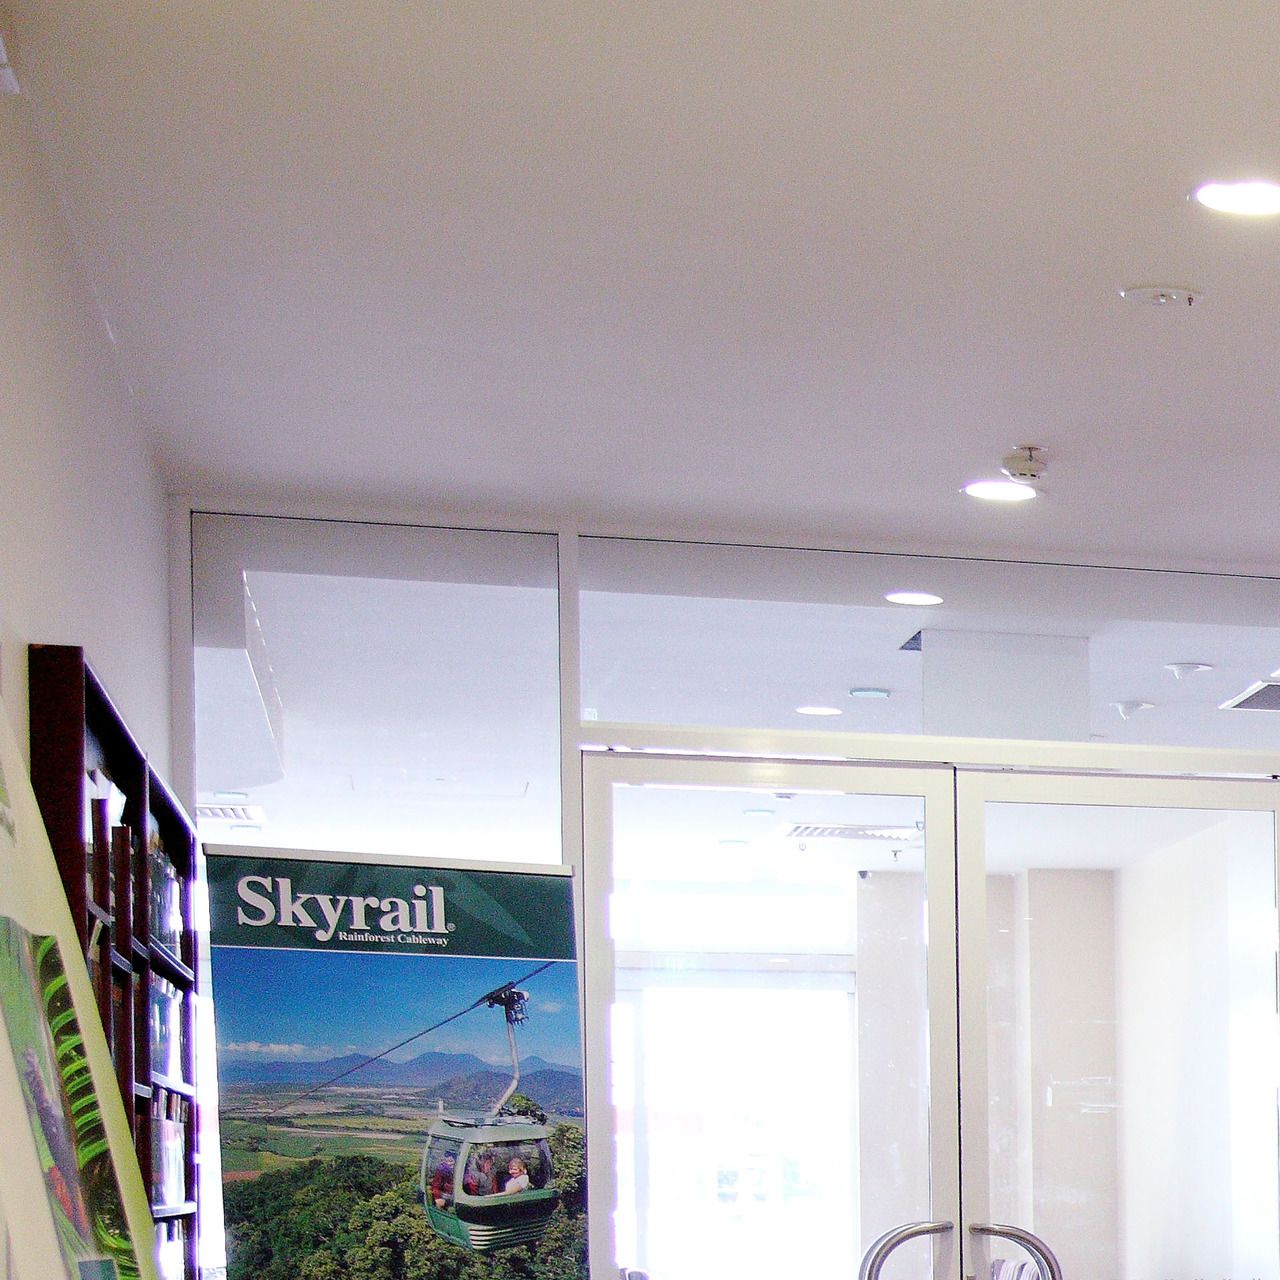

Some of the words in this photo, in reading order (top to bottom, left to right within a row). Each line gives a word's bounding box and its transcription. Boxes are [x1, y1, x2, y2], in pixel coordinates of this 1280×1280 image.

[236, 875, 450, 942] Skyrail
[338, 931, 395, 943] Rainforest
[397, 933, 450, 947] Cableway
